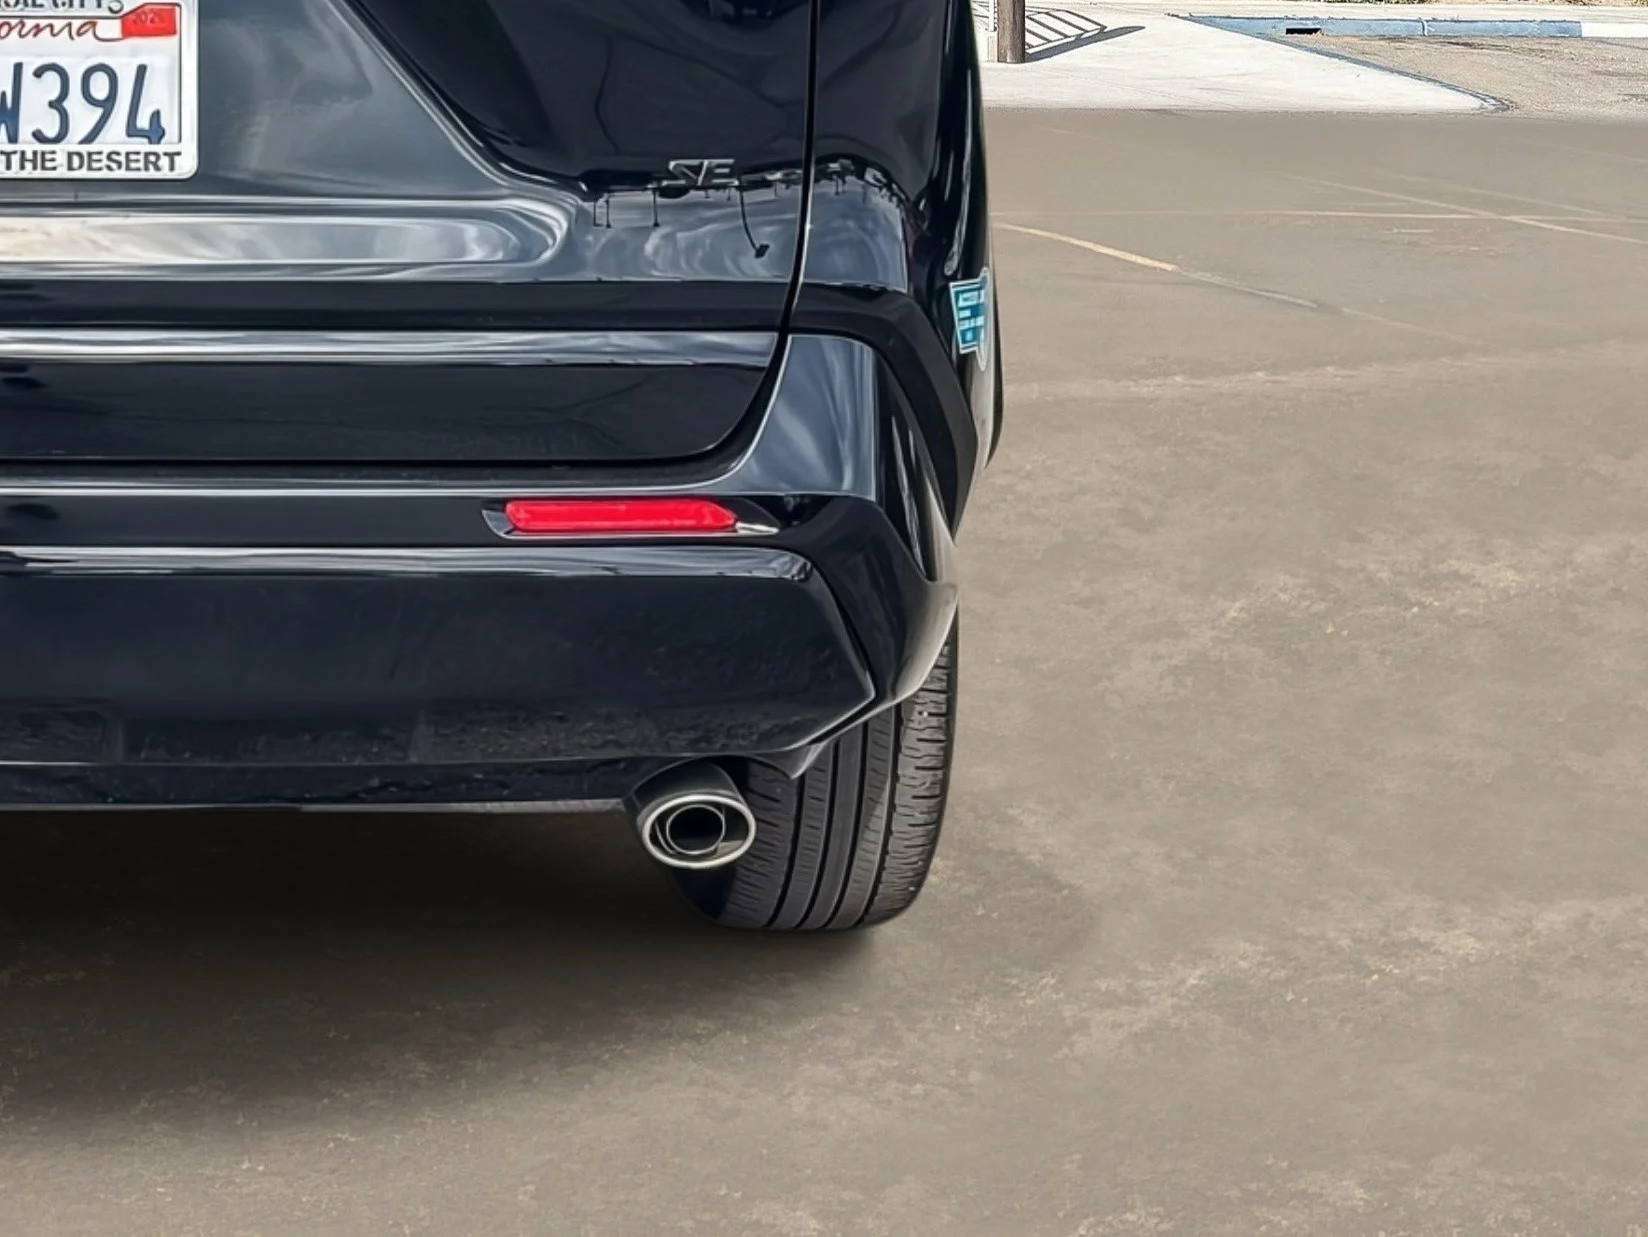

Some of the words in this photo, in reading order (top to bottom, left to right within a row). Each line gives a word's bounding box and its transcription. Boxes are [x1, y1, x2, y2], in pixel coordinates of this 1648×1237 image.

[0, 150, 57, 172] THE
[66, 150, 182, 173] DESERT
[661, 158, 739, 186] SE
